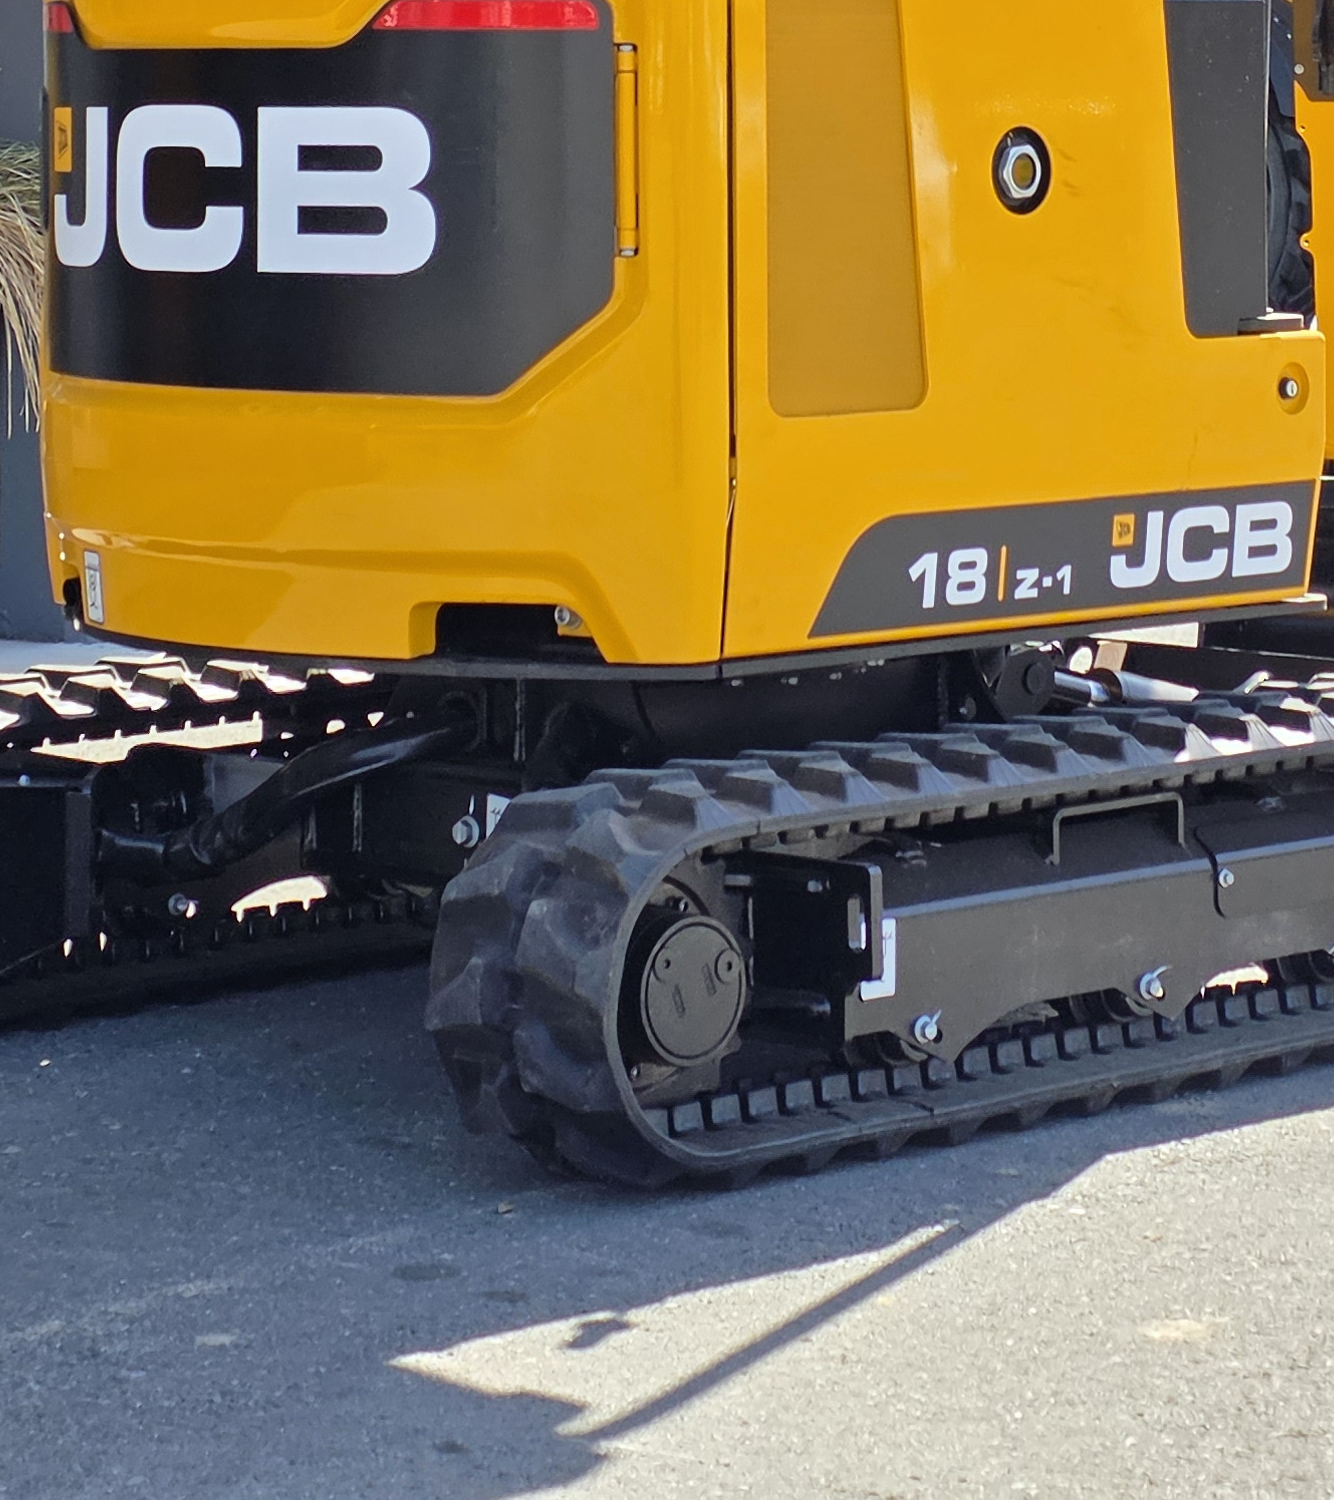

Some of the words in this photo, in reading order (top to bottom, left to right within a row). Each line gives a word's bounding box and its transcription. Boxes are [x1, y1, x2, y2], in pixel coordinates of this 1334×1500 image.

[54, 104, 437, 275] JCB
[908, 547, 989, 609] 18
[1110, 501, 1293, 589] JCB
